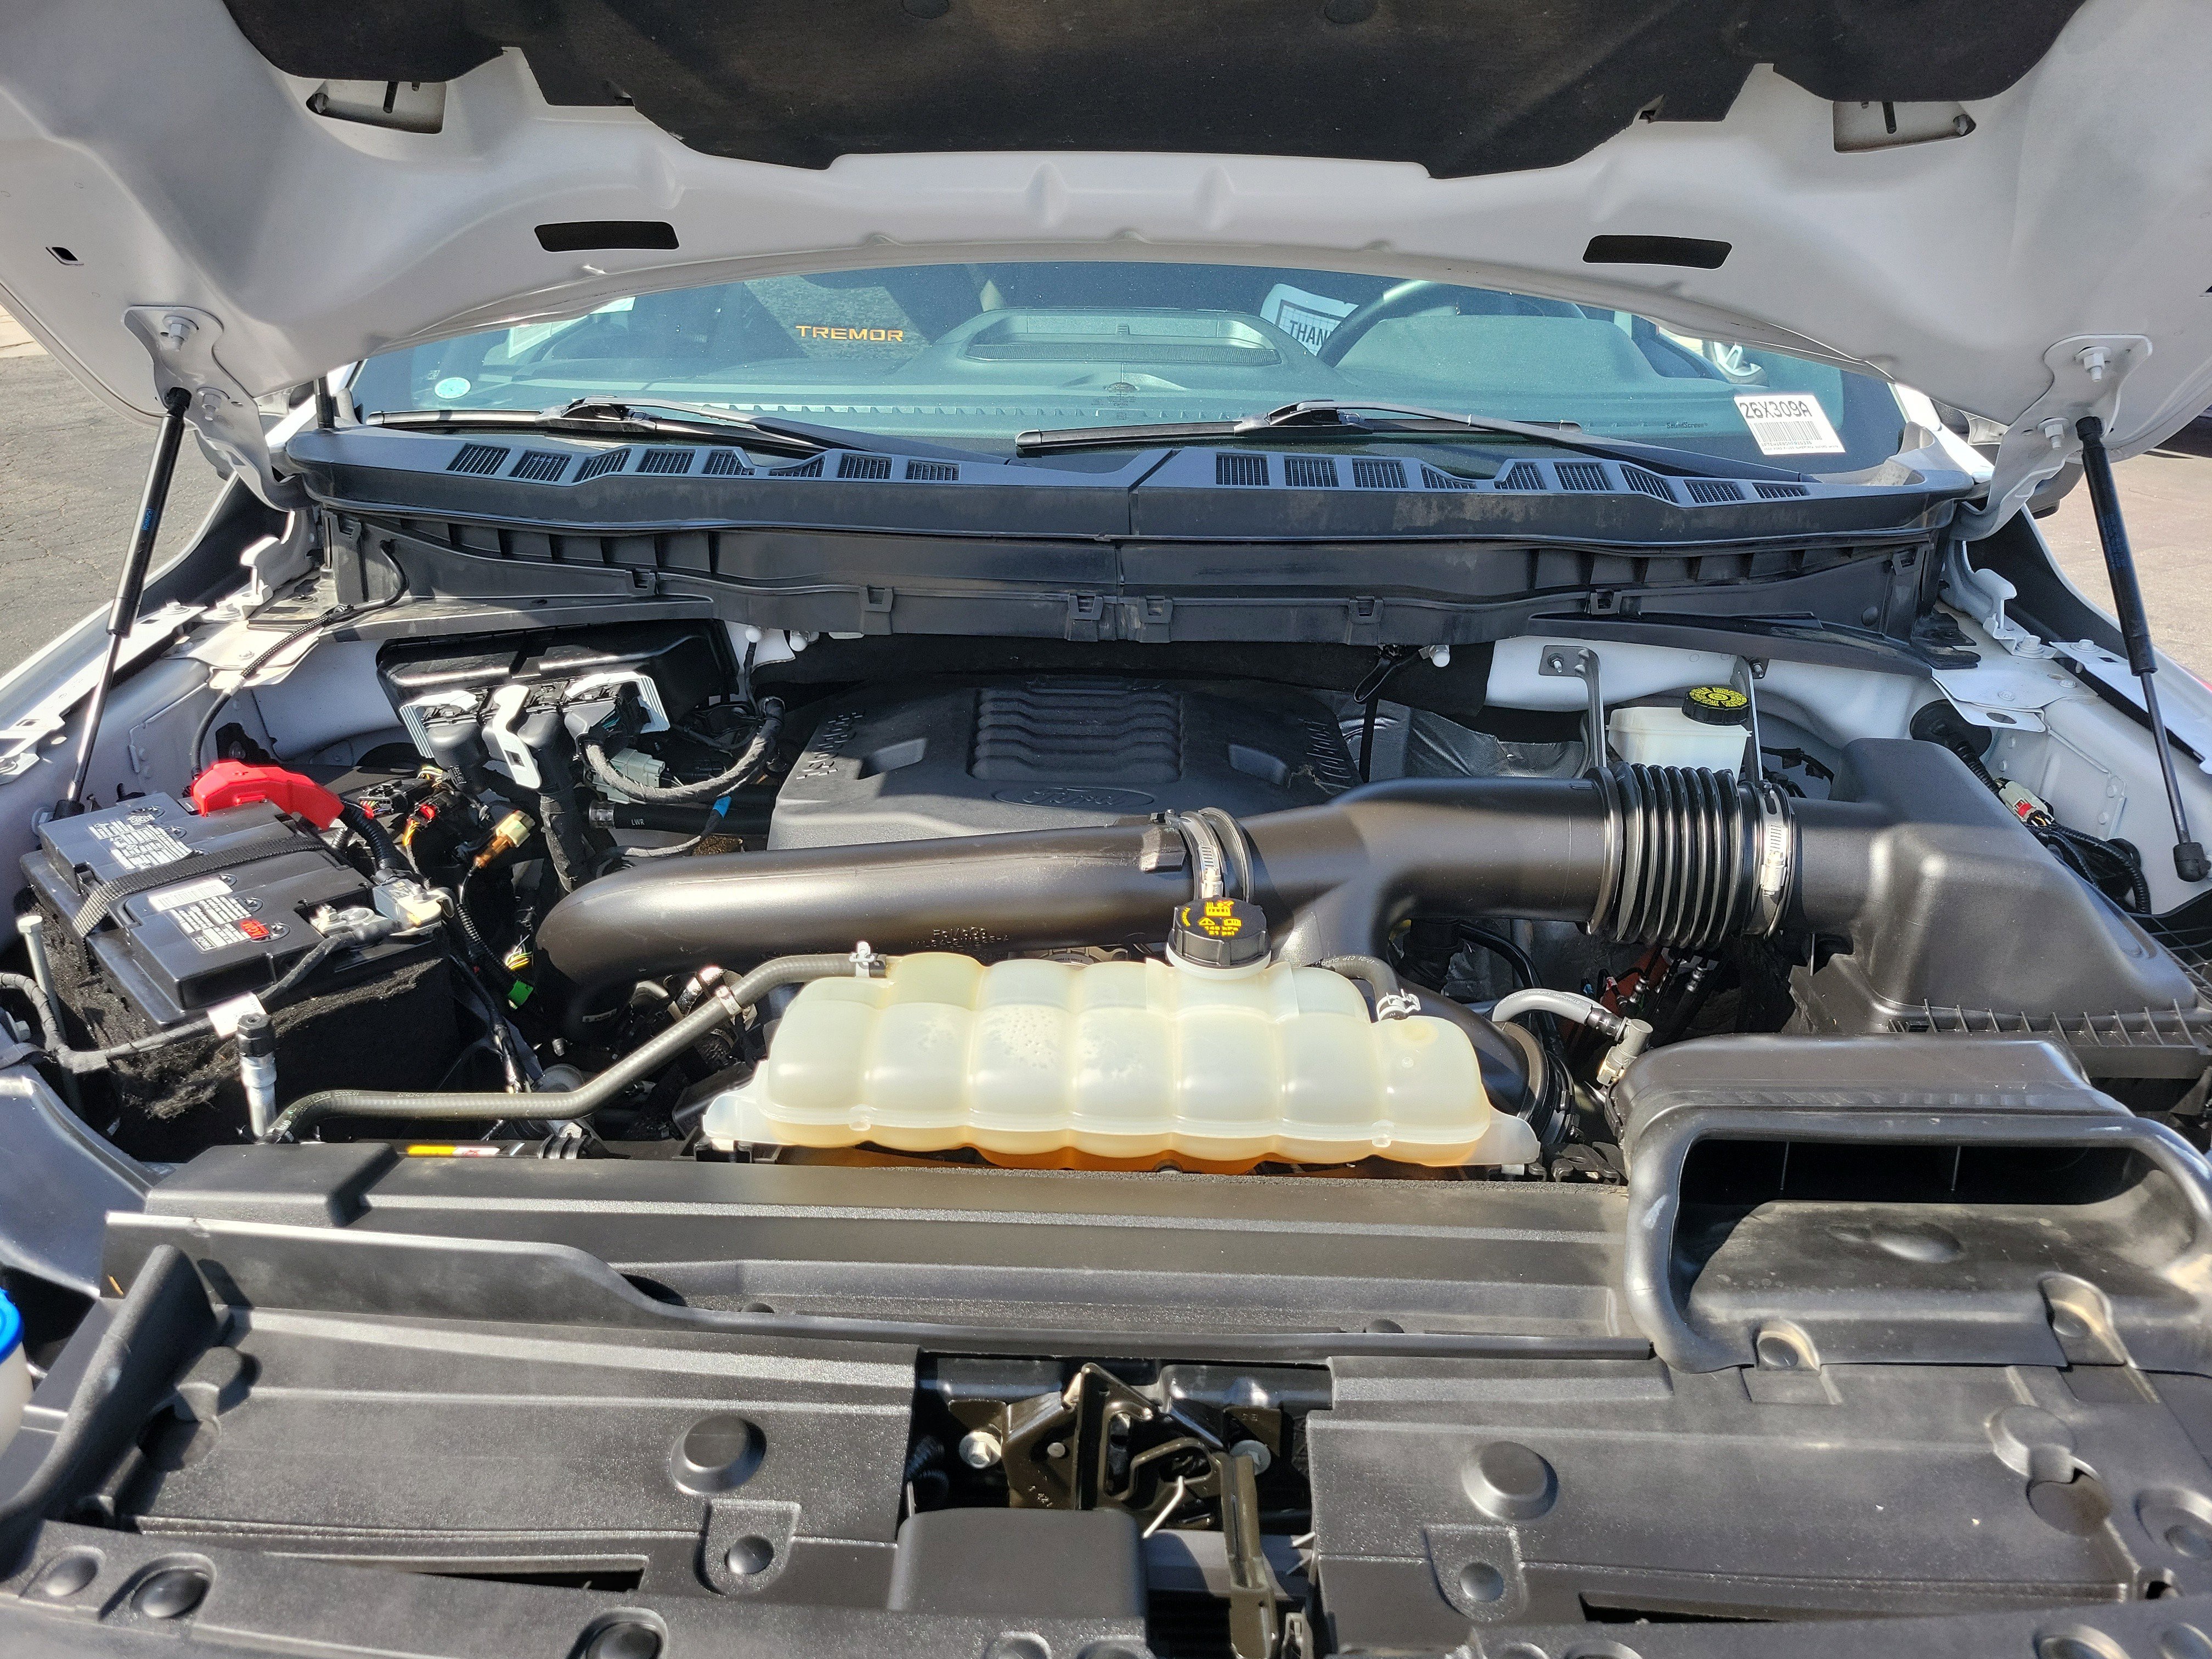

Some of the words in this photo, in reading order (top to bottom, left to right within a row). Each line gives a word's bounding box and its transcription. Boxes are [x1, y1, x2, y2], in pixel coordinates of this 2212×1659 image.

[795, 325, 904, 342] TREMOR
[1290, 320, 1330, 346] THAN
[1740, 400, 1813, 419] 26X309A
